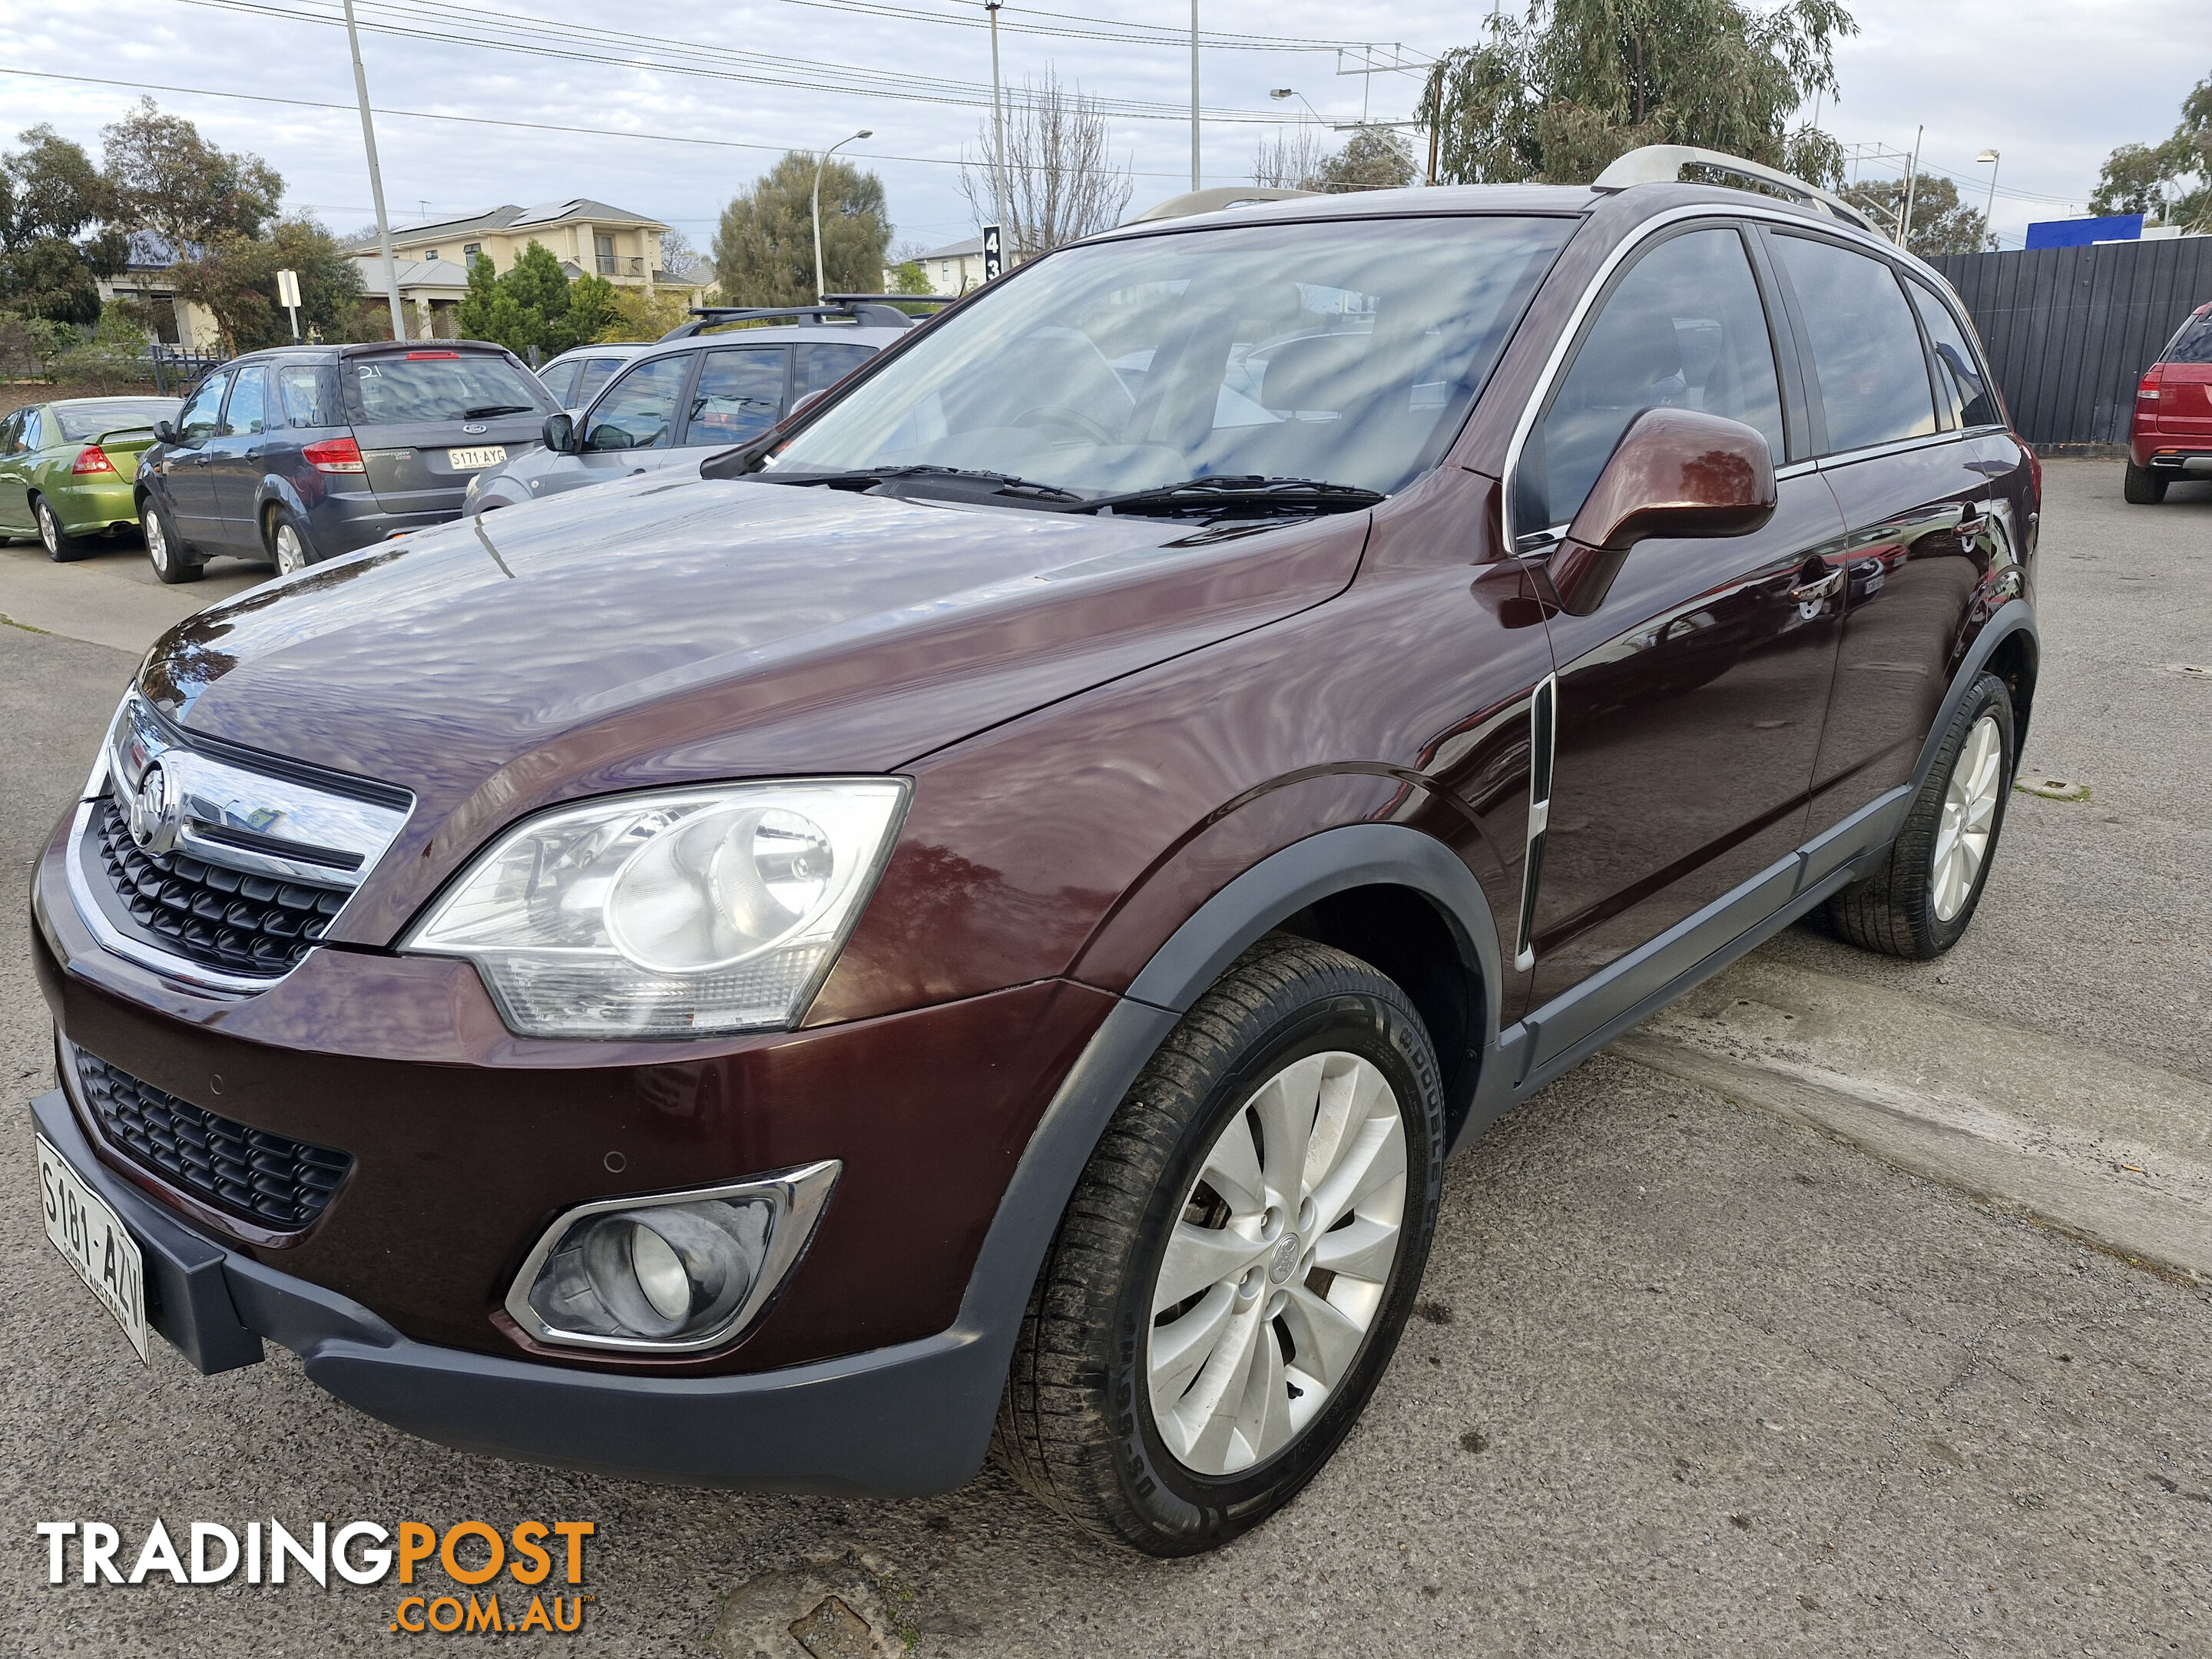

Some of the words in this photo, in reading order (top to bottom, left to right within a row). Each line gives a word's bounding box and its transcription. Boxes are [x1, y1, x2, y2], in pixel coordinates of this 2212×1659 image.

[358, 365, 382, 379] 21
[1410, 1048, 1442, 1184] DOUBLE
[64, 1242, 87, 1279] SOUTH
[89, 1273, 129, 1331] AUSTRALIA
